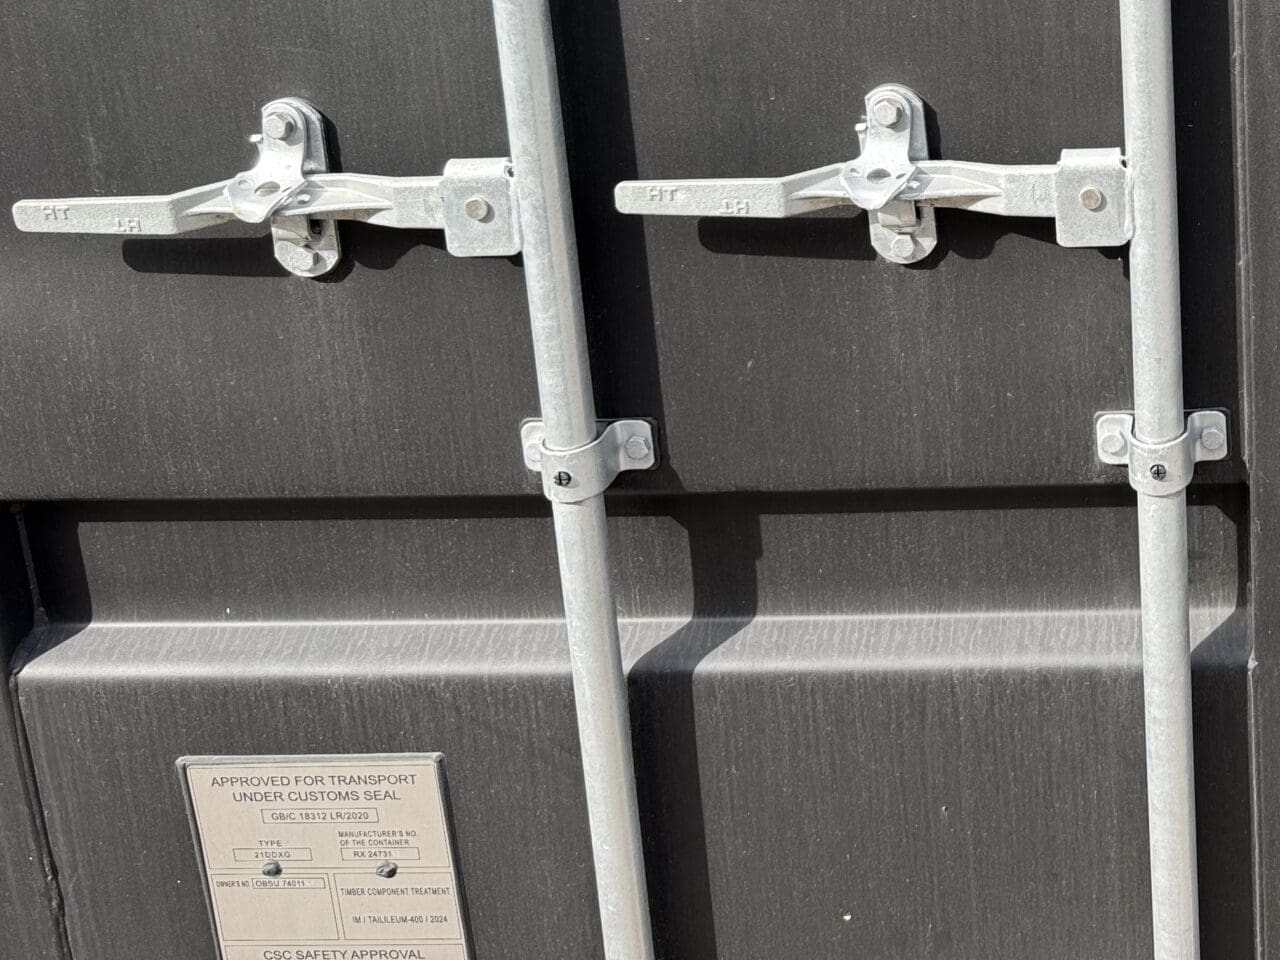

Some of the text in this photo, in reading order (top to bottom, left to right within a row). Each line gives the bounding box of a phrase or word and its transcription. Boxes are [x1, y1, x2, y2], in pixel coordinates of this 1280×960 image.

[211, 774, 417, 787] APPROVED FOR TRANSPORT
[232, 790, 401, 802] UNDER CUSTOMS SEAL
[299, 811, 327, 821] 18312
[330, 810, 369, 820] LR/2020
[338, 830, 404, 838] MANUFACTURER'S
[368, 838, 410, 846] CONTAINER
[340, 887, 450, 896] TIMBER COMPONENT TREATMENT
[430, 915, 448, 923] 2024
[263, 949, 425, 960] CSC SAFETY APPROVAL
